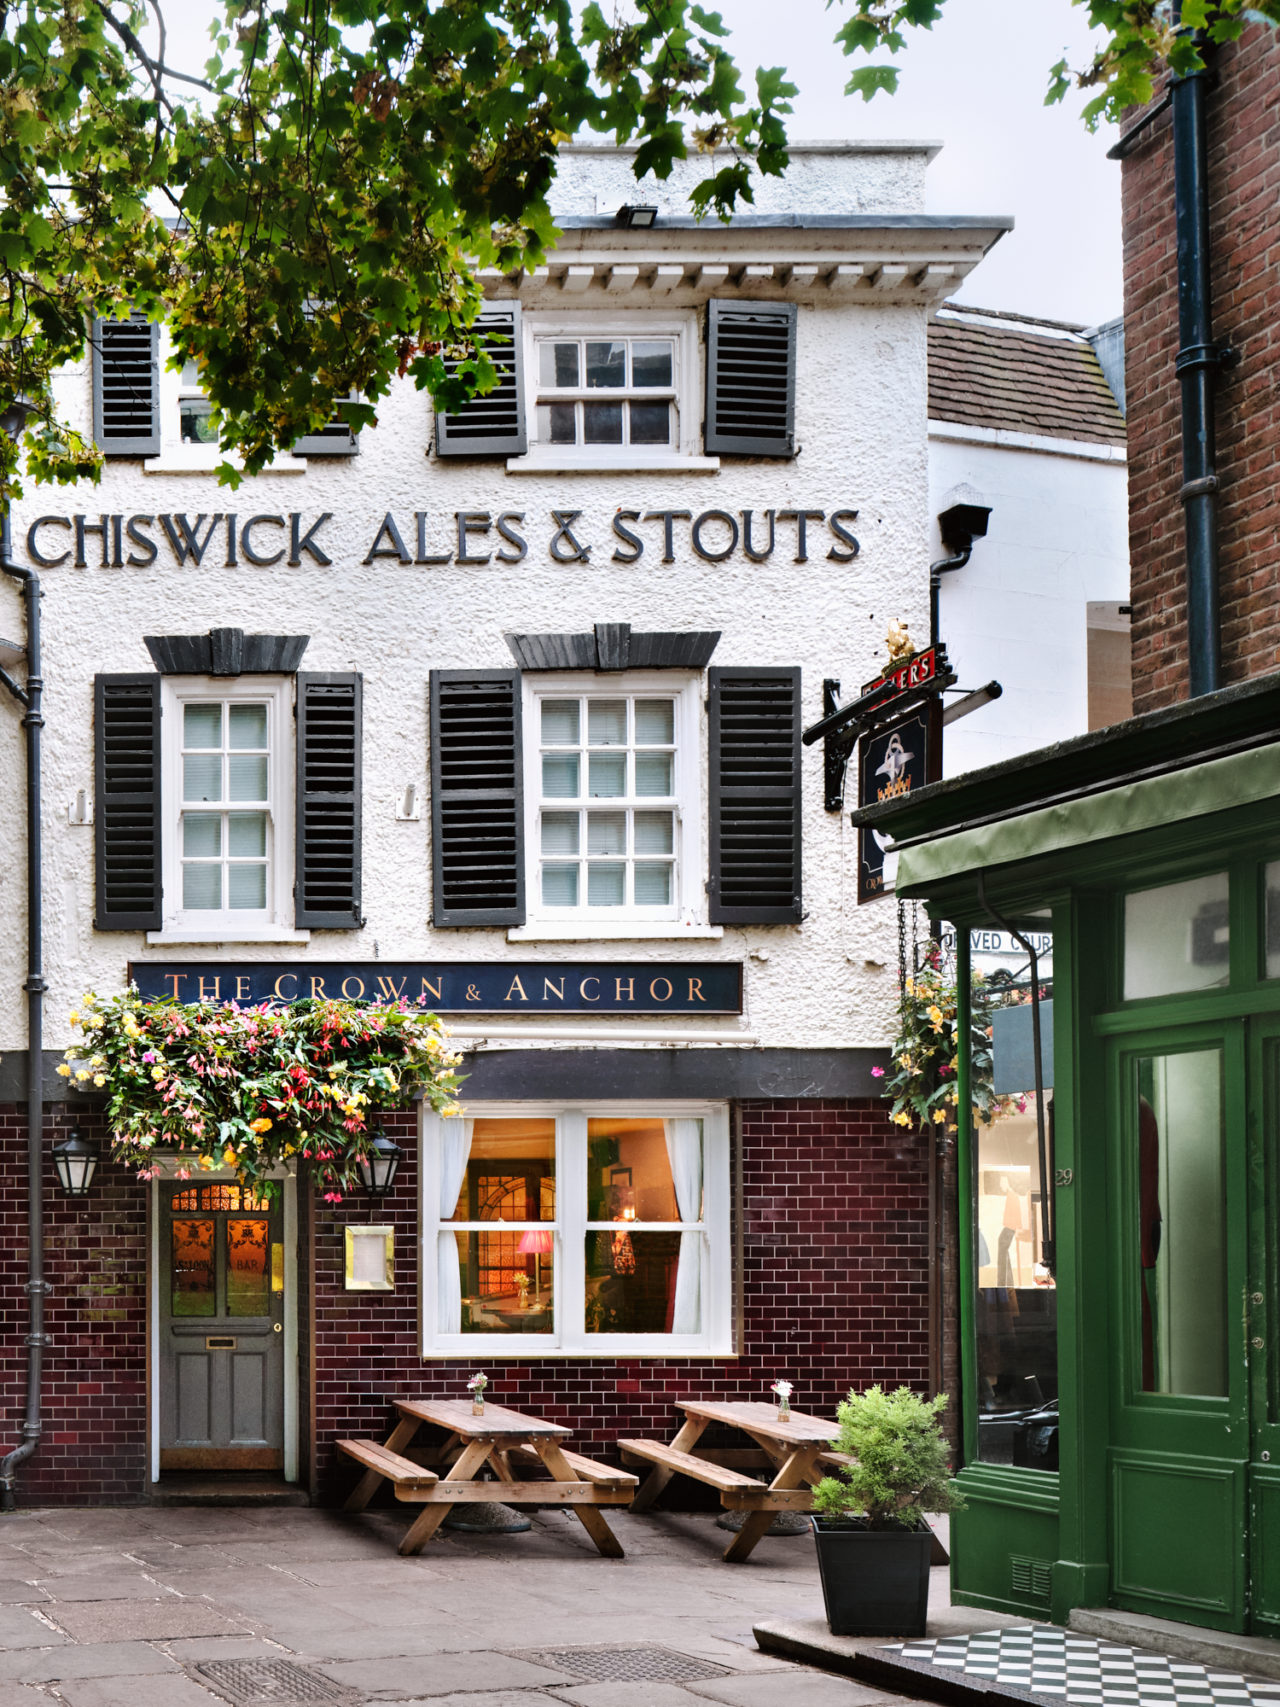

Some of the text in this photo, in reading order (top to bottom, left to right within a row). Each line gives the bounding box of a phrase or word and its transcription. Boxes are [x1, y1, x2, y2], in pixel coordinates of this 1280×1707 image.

[27, 512, 333, 567] CHISWICK
[362, 511, 528, 565] ALES
[551, 509, 592, 563] &
[613, 509, 860, 563] STOUTS
[164, 973, 707, 1001] THE CROWN & ANCHOR
[1055, 1168, 1073, 1186] 29
[236, 1259, 259, 1271] BAR
